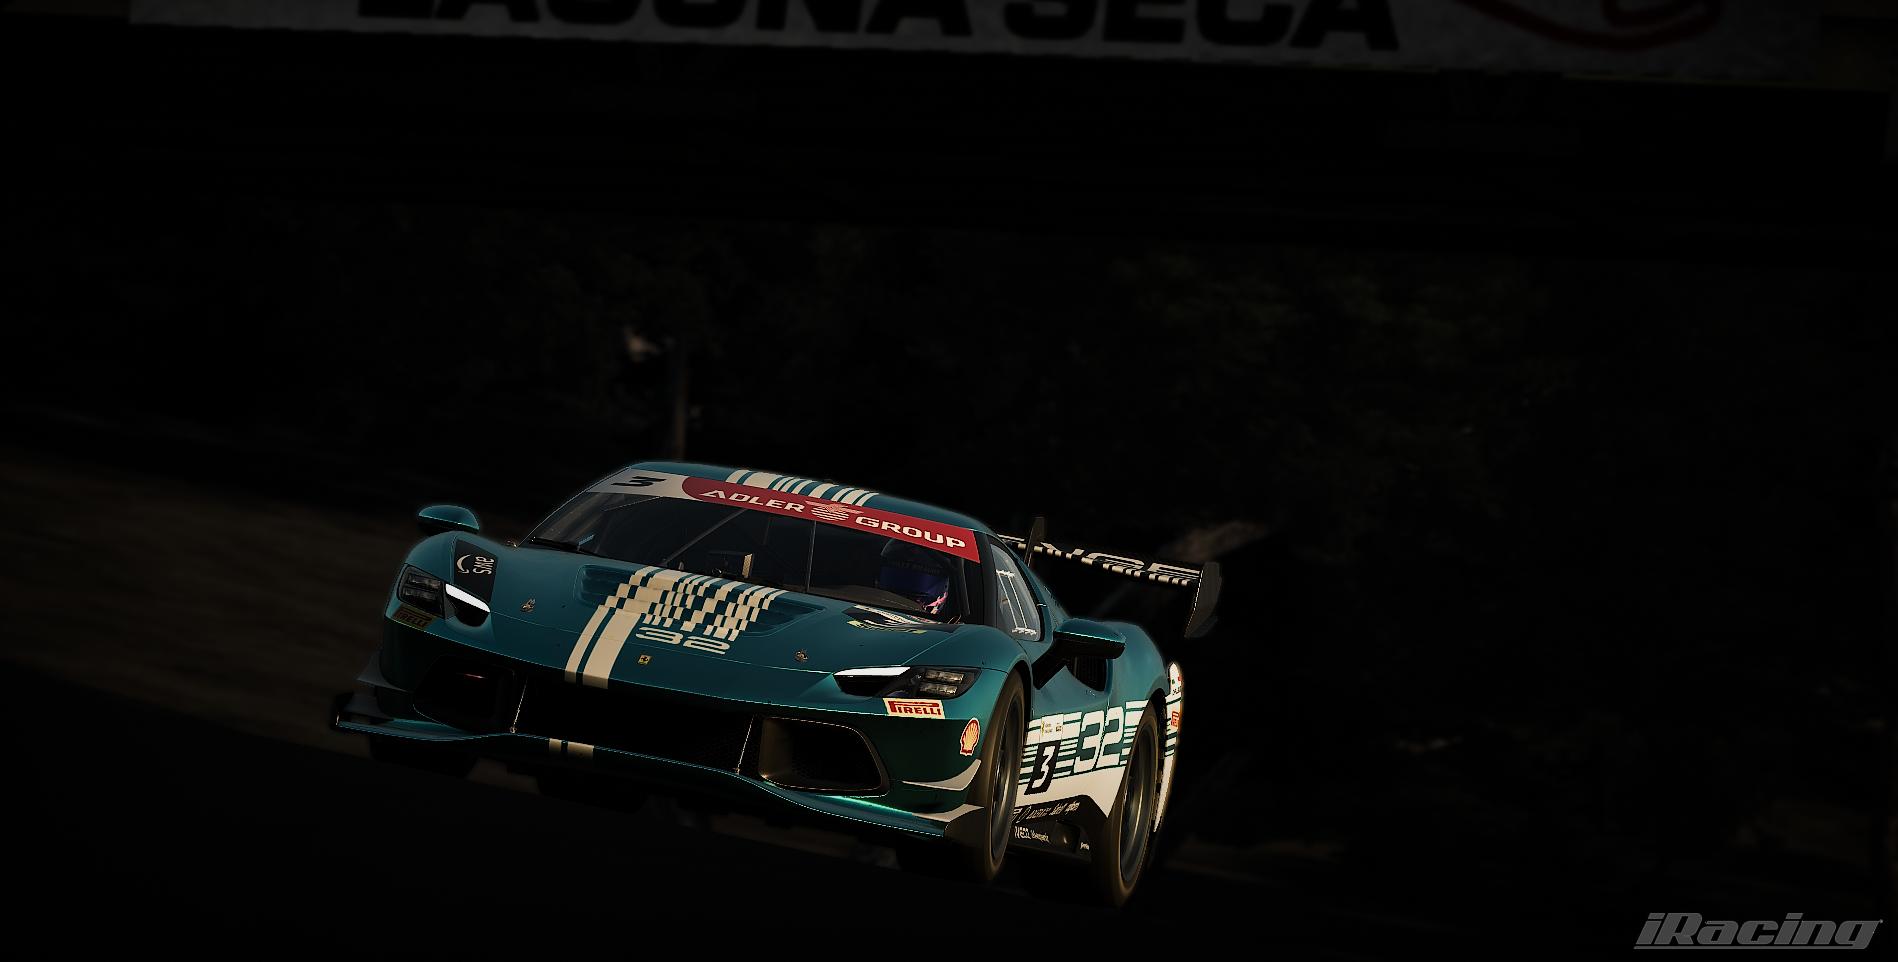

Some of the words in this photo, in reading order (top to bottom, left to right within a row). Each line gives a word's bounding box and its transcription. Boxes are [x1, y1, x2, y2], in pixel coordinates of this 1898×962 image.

[612, 475, 666, 488] 3
[700, 489, 806, 514] ADLER
[854, 515, 967, 549] GROUP
[635, 626, 731, 655] 32
[887, 700, 942, 716] PIRELLI
[1073, 707, 1125, 774] 32
[1031, 744, 1057, 789] 3
